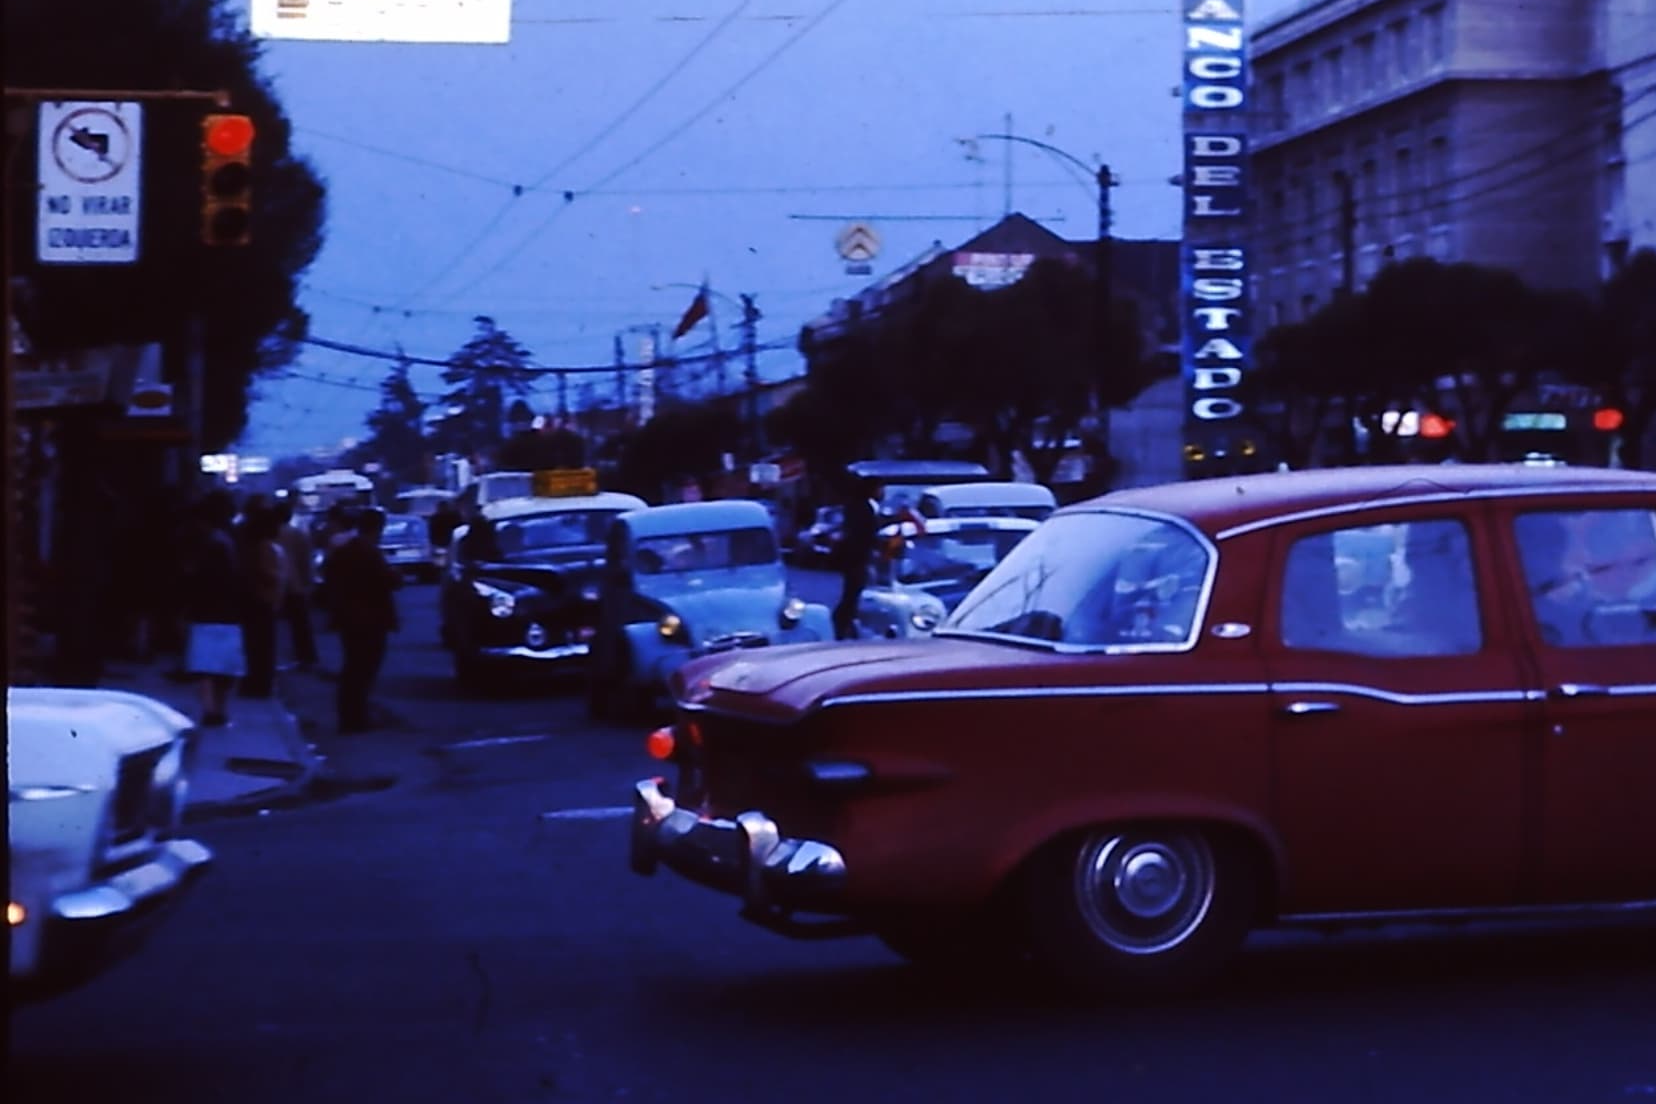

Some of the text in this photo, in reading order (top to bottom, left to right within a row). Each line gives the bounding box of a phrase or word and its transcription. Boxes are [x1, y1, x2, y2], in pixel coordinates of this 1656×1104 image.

[48, 195, 131, 215] NO VIRAR
[1191, 135, 1242, 217] DEL
[1192, 249, 1244, 420] ESTADO
